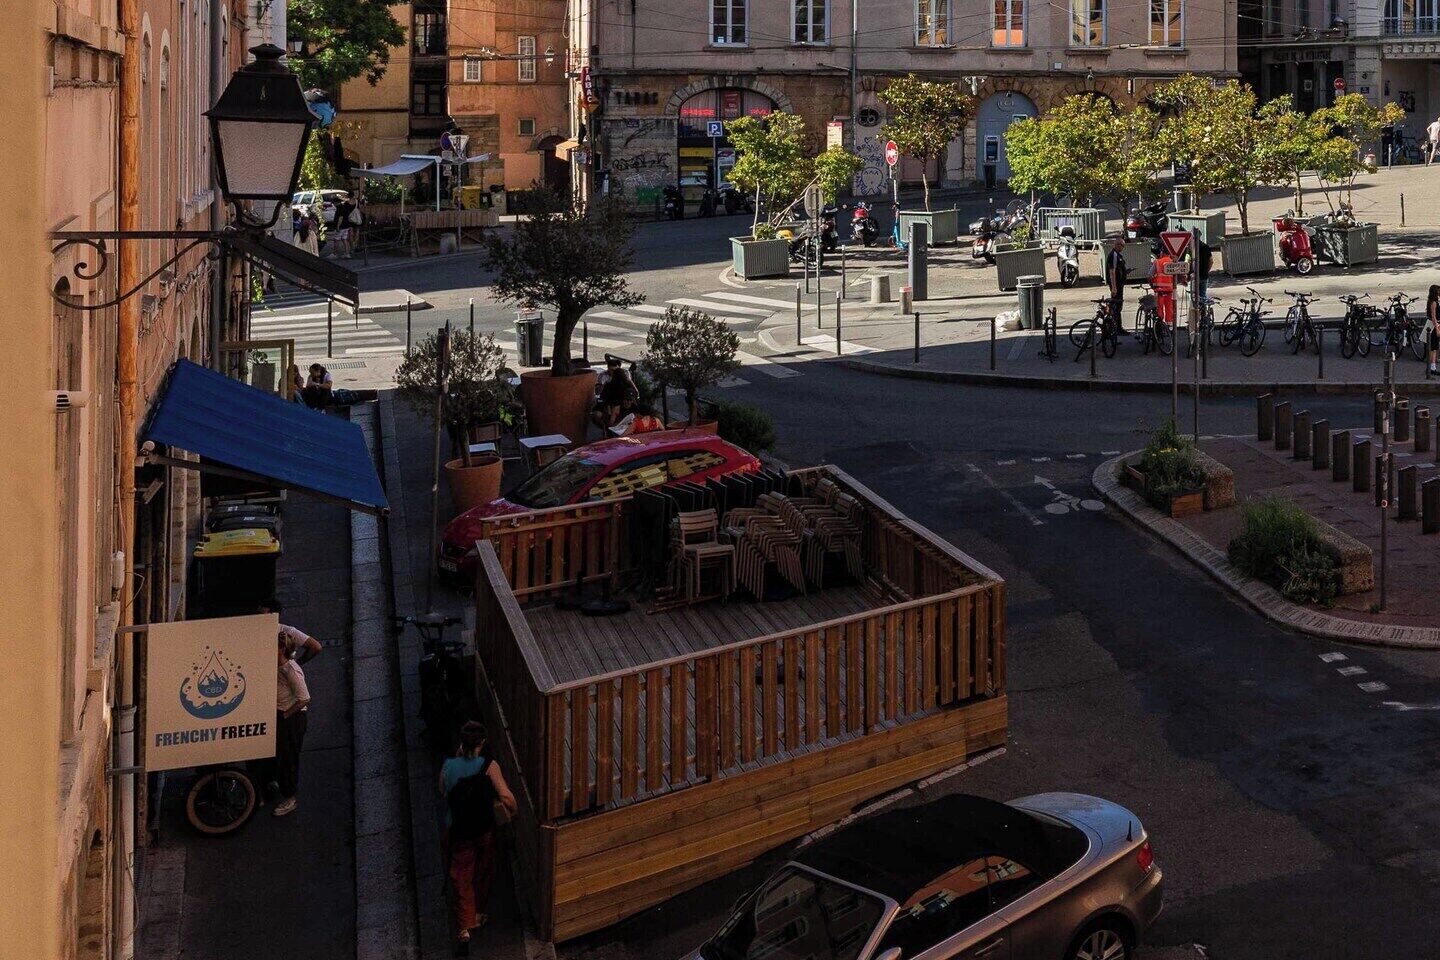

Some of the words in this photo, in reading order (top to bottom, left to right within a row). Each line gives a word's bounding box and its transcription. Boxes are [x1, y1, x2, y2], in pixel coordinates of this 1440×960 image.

[584, 67, 593, 102] TABAC
[155, 728, 219, 747] FRENCHY
[221, 722, 267, 740] FREEZE
